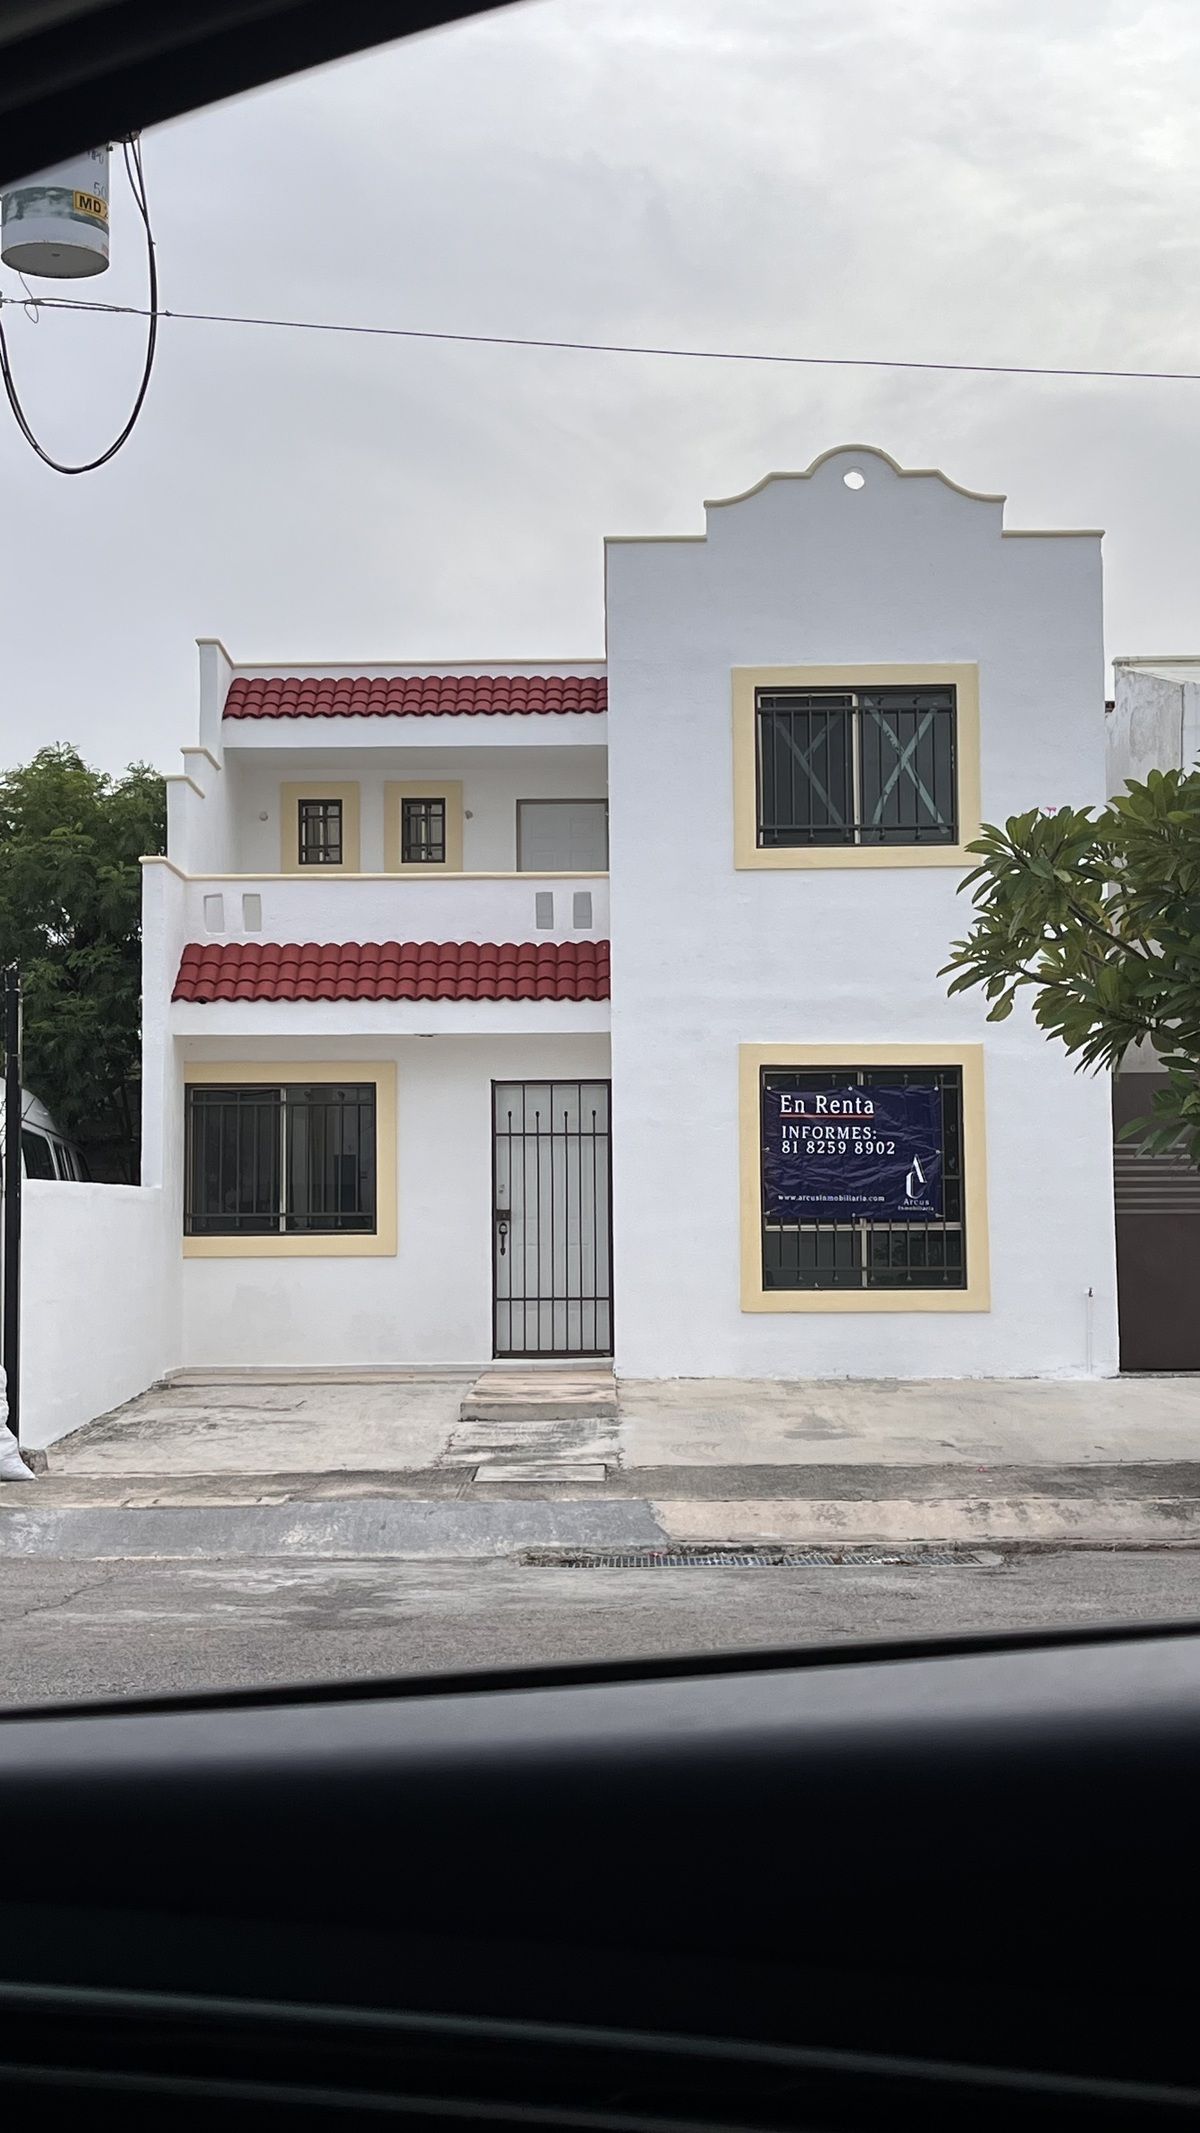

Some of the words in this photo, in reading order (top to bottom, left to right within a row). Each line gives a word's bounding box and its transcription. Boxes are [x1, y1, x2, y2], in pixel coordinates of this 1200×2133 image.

[780, 1094, 805, 1113] En
[815, 1095, 874, 1114] Renta
[781, 1125, 877, 1140] INFORMES:
[781, 1140, 798, 1154] 81
[806, 1140, 847, 1154] 8259
[854, 1141, 896, 1155] 8902
[903, 1198, 930, 1206] Arcus
